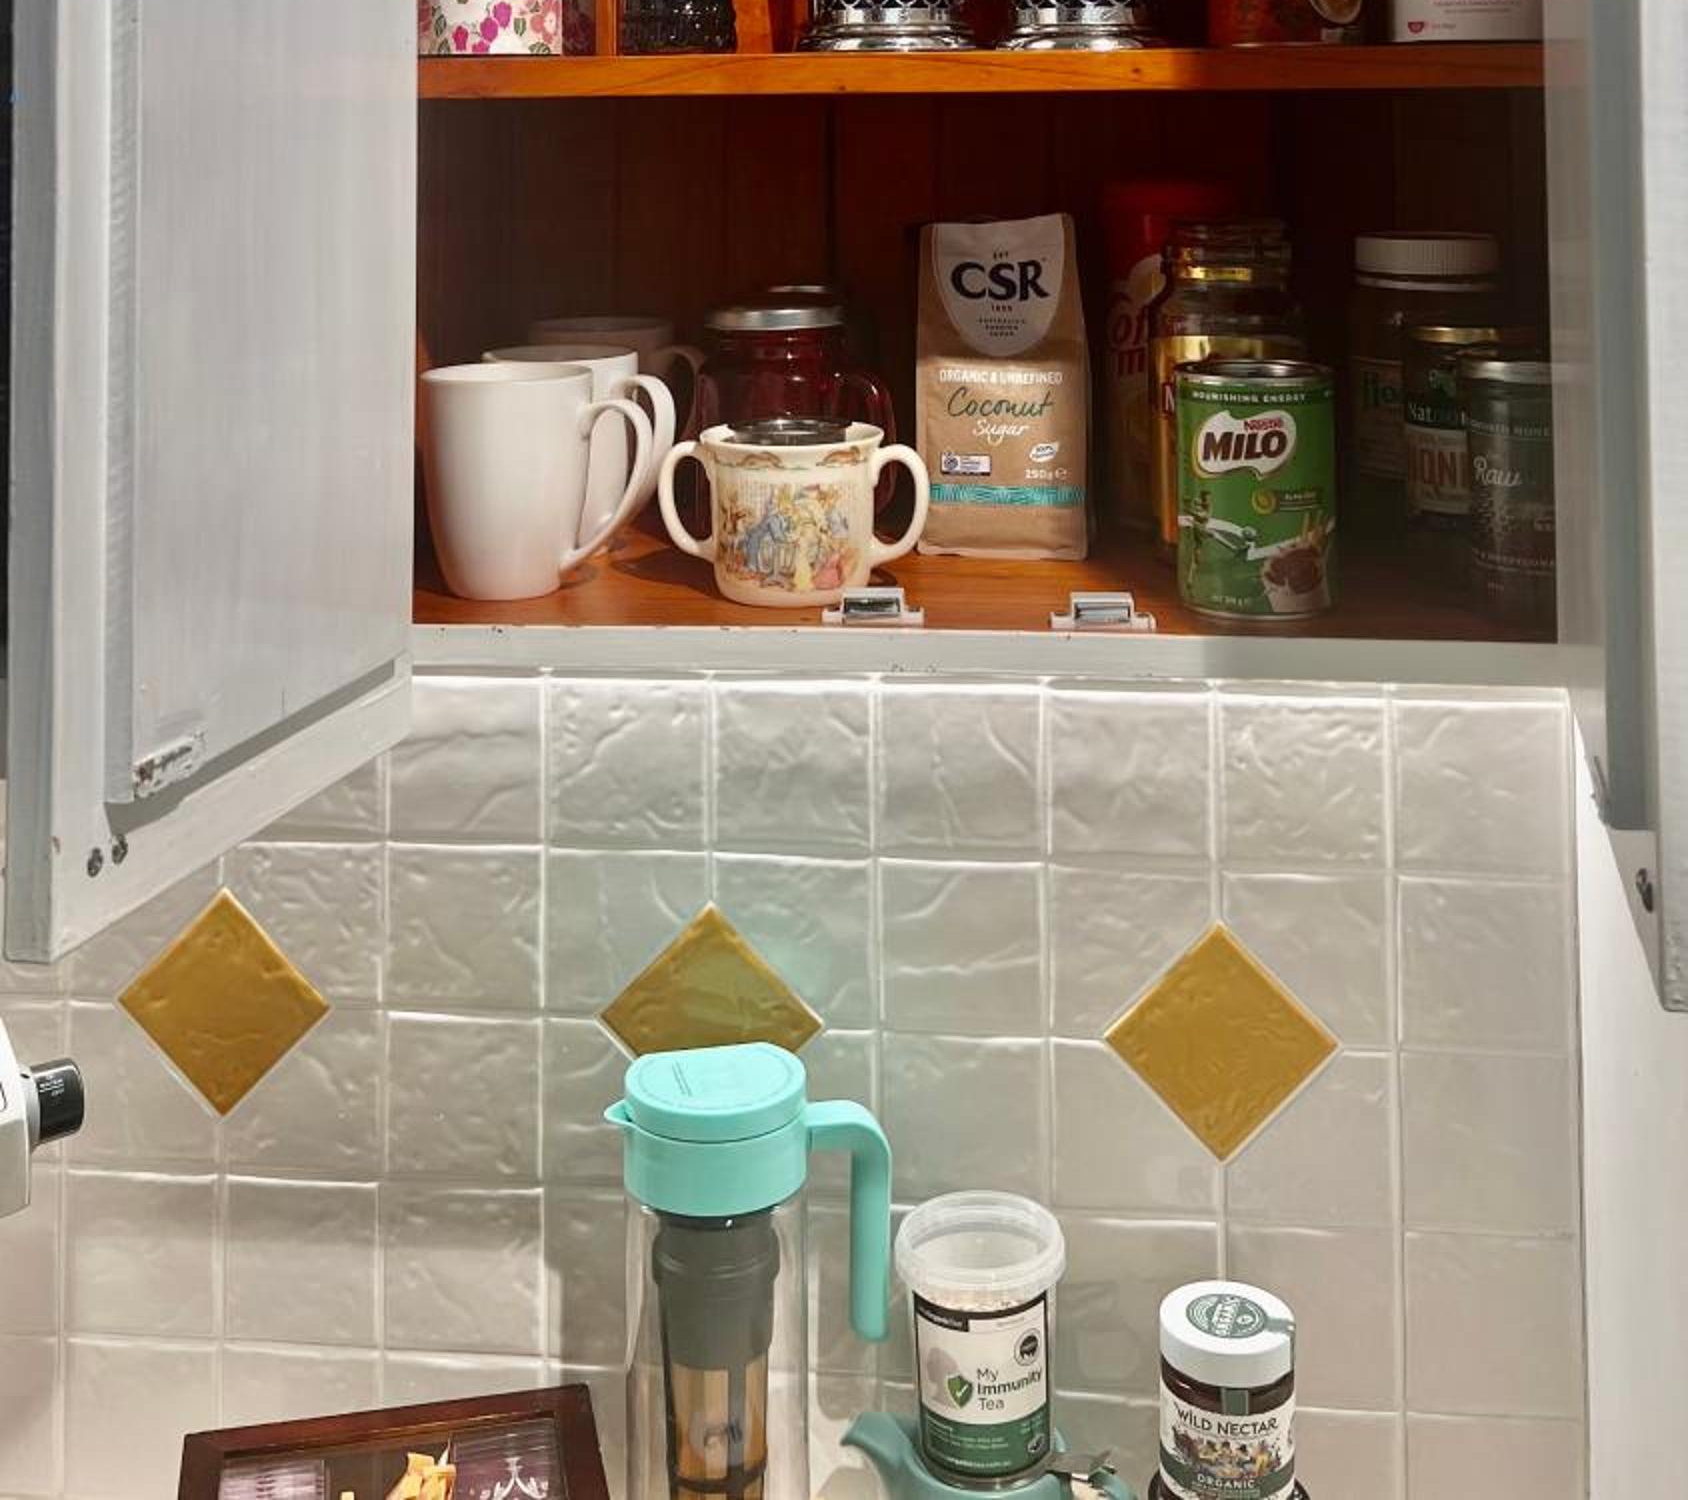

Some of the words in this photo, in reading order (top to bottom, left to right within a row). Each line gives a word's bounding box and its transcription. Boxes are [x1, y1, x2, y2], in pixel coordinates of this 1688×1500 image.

[951, 260, 1051, 302] CSR
[939, 369, 987, 383] ORGANIC
[947, 385, 1054, 417] Coconut
[1192, 390, 1259, 403] NOURISHING
[972, 418, 1031, 446] Sugar
[1202, 429, 1288, 461] MILO
[977, 1368, 999, 1382] My
[977, 1368, 1042, 1395] Immunity
[978, 1398, 1005, 1411] Tea
[1217, 1417, 1278, 1436] NECTAR
[1197, 1473, 1255, 1489] ORGANIC
